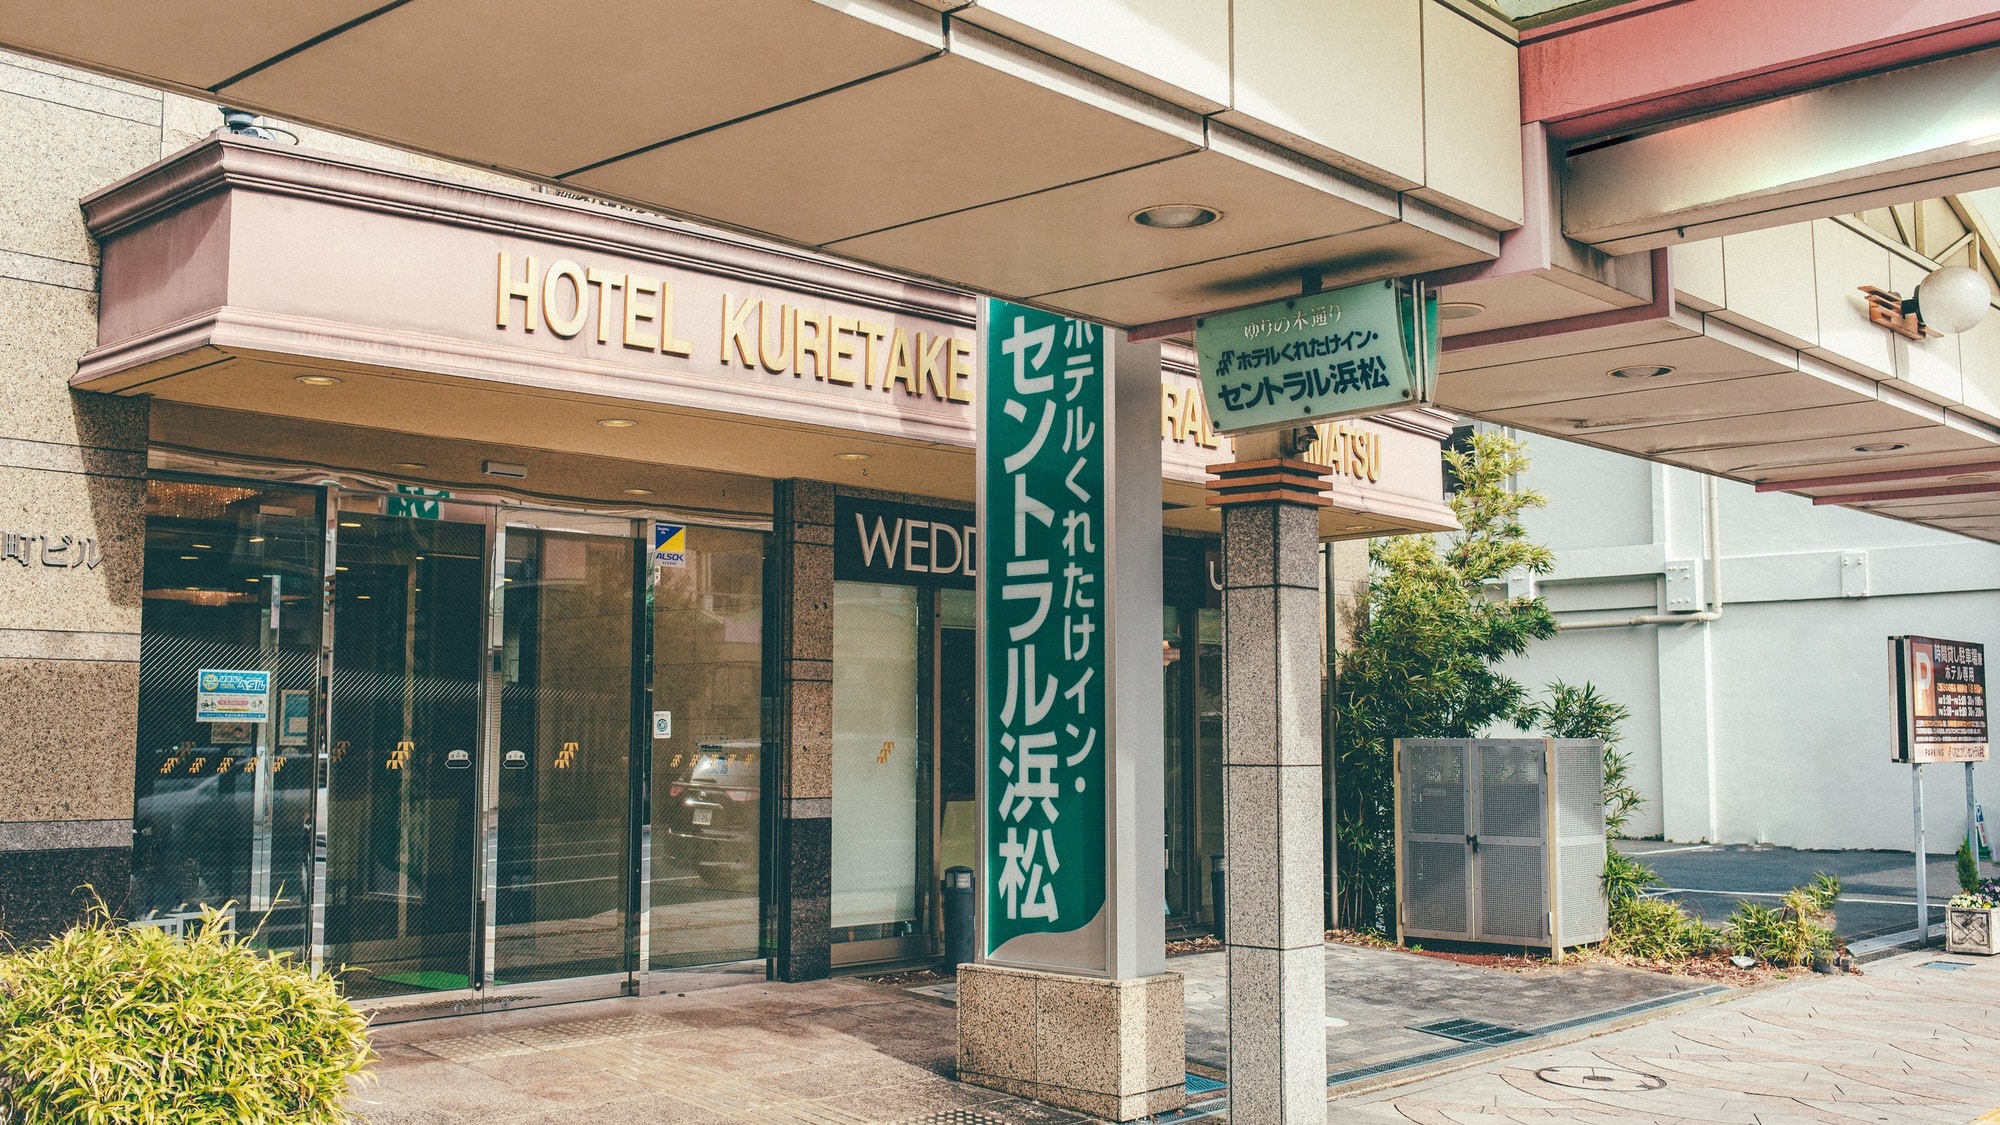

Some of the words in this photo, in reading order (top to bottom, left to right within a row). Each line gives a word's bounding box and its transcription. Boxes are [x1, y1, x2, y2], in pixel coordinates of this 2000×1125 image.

[496, 252, 693, 357] HOTEL
[720, 293, 974, 403] KURETAKE
[1244, 304, 1343, 340] ゆりの木通り
[1218, 355, 1391, 411] セントラル浜松
[1, 531, 106, 570] 町ビル
[656, 552, 684, 562] ALSOK
[999, 315, 1061, 923] セントラル浜松
[1915, 651, 1932, 711] P
